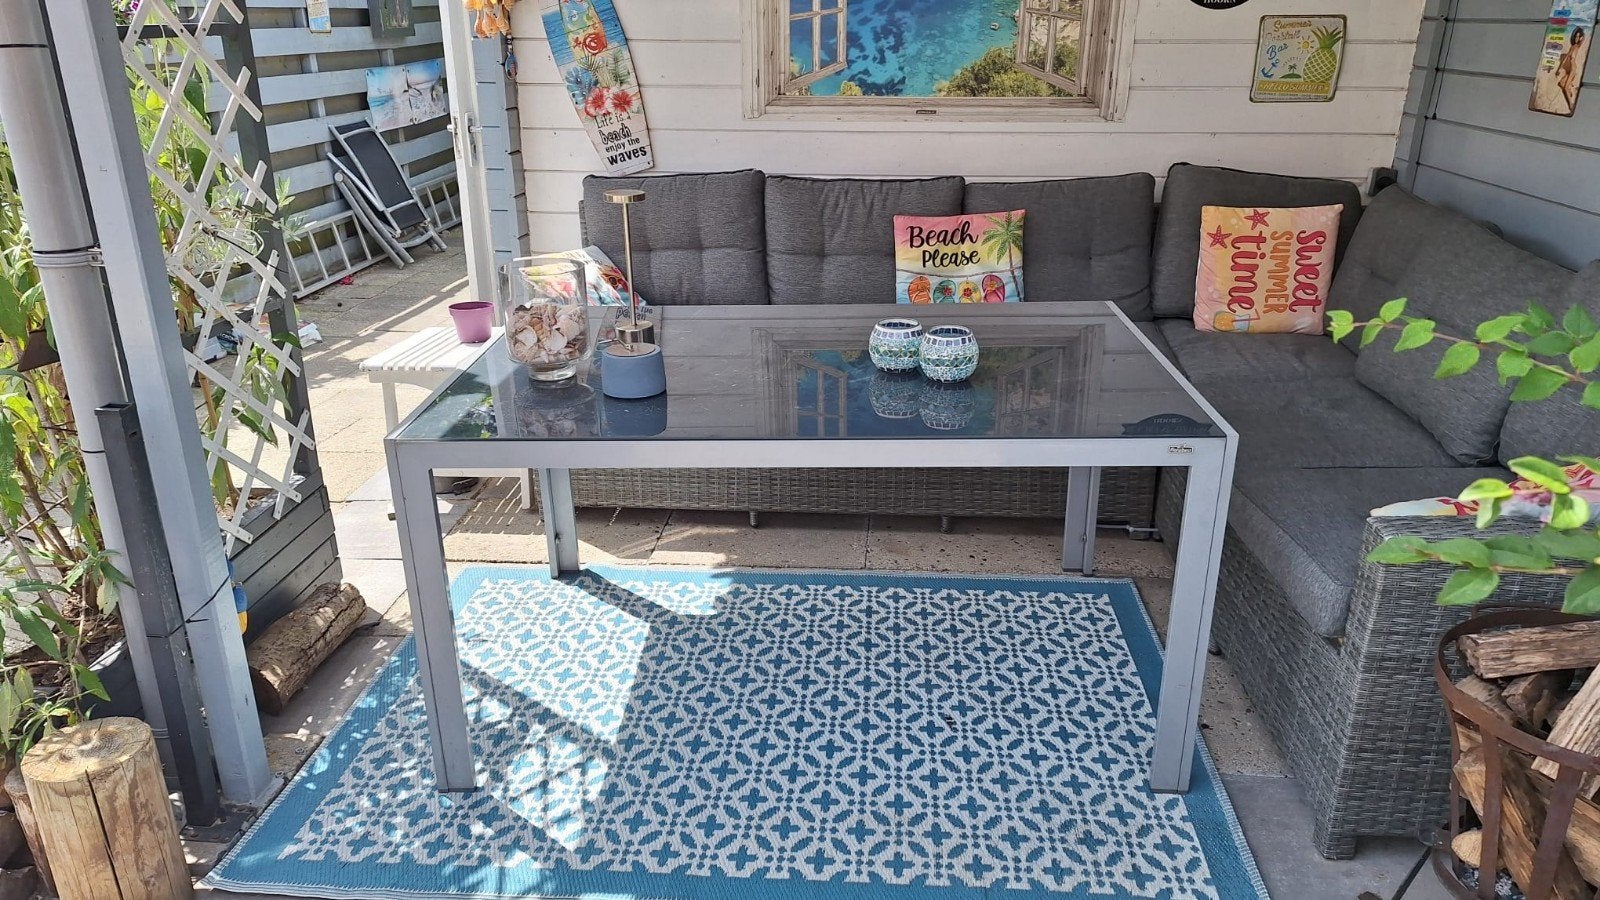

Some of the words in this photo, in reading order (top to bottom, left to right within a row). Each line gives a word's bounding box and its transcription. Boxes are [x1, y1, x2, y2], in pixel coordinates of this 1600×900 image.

[1266, 42, 1289, 60] Bar
[1263, 81, 1289, 91] HELLO
[1290, 82, 1324, 92] SUMMER
[594, 115, 614, 129] Life
[615, 112, 624, 122] is
[598, 123, 632, 145] beach
[605, 142, 626, 153] enjoy
[627, 137, 640, 146] the
[607, 146, 647, 166] waves
[906, 220, 979, 249] Beach
[921, 248, 981, 268] Please
[1226, 230, 1267, 313] time
[1262, 230, 1294, 314] SUMMER
[1288, 229, 1327, 313] Sweet
